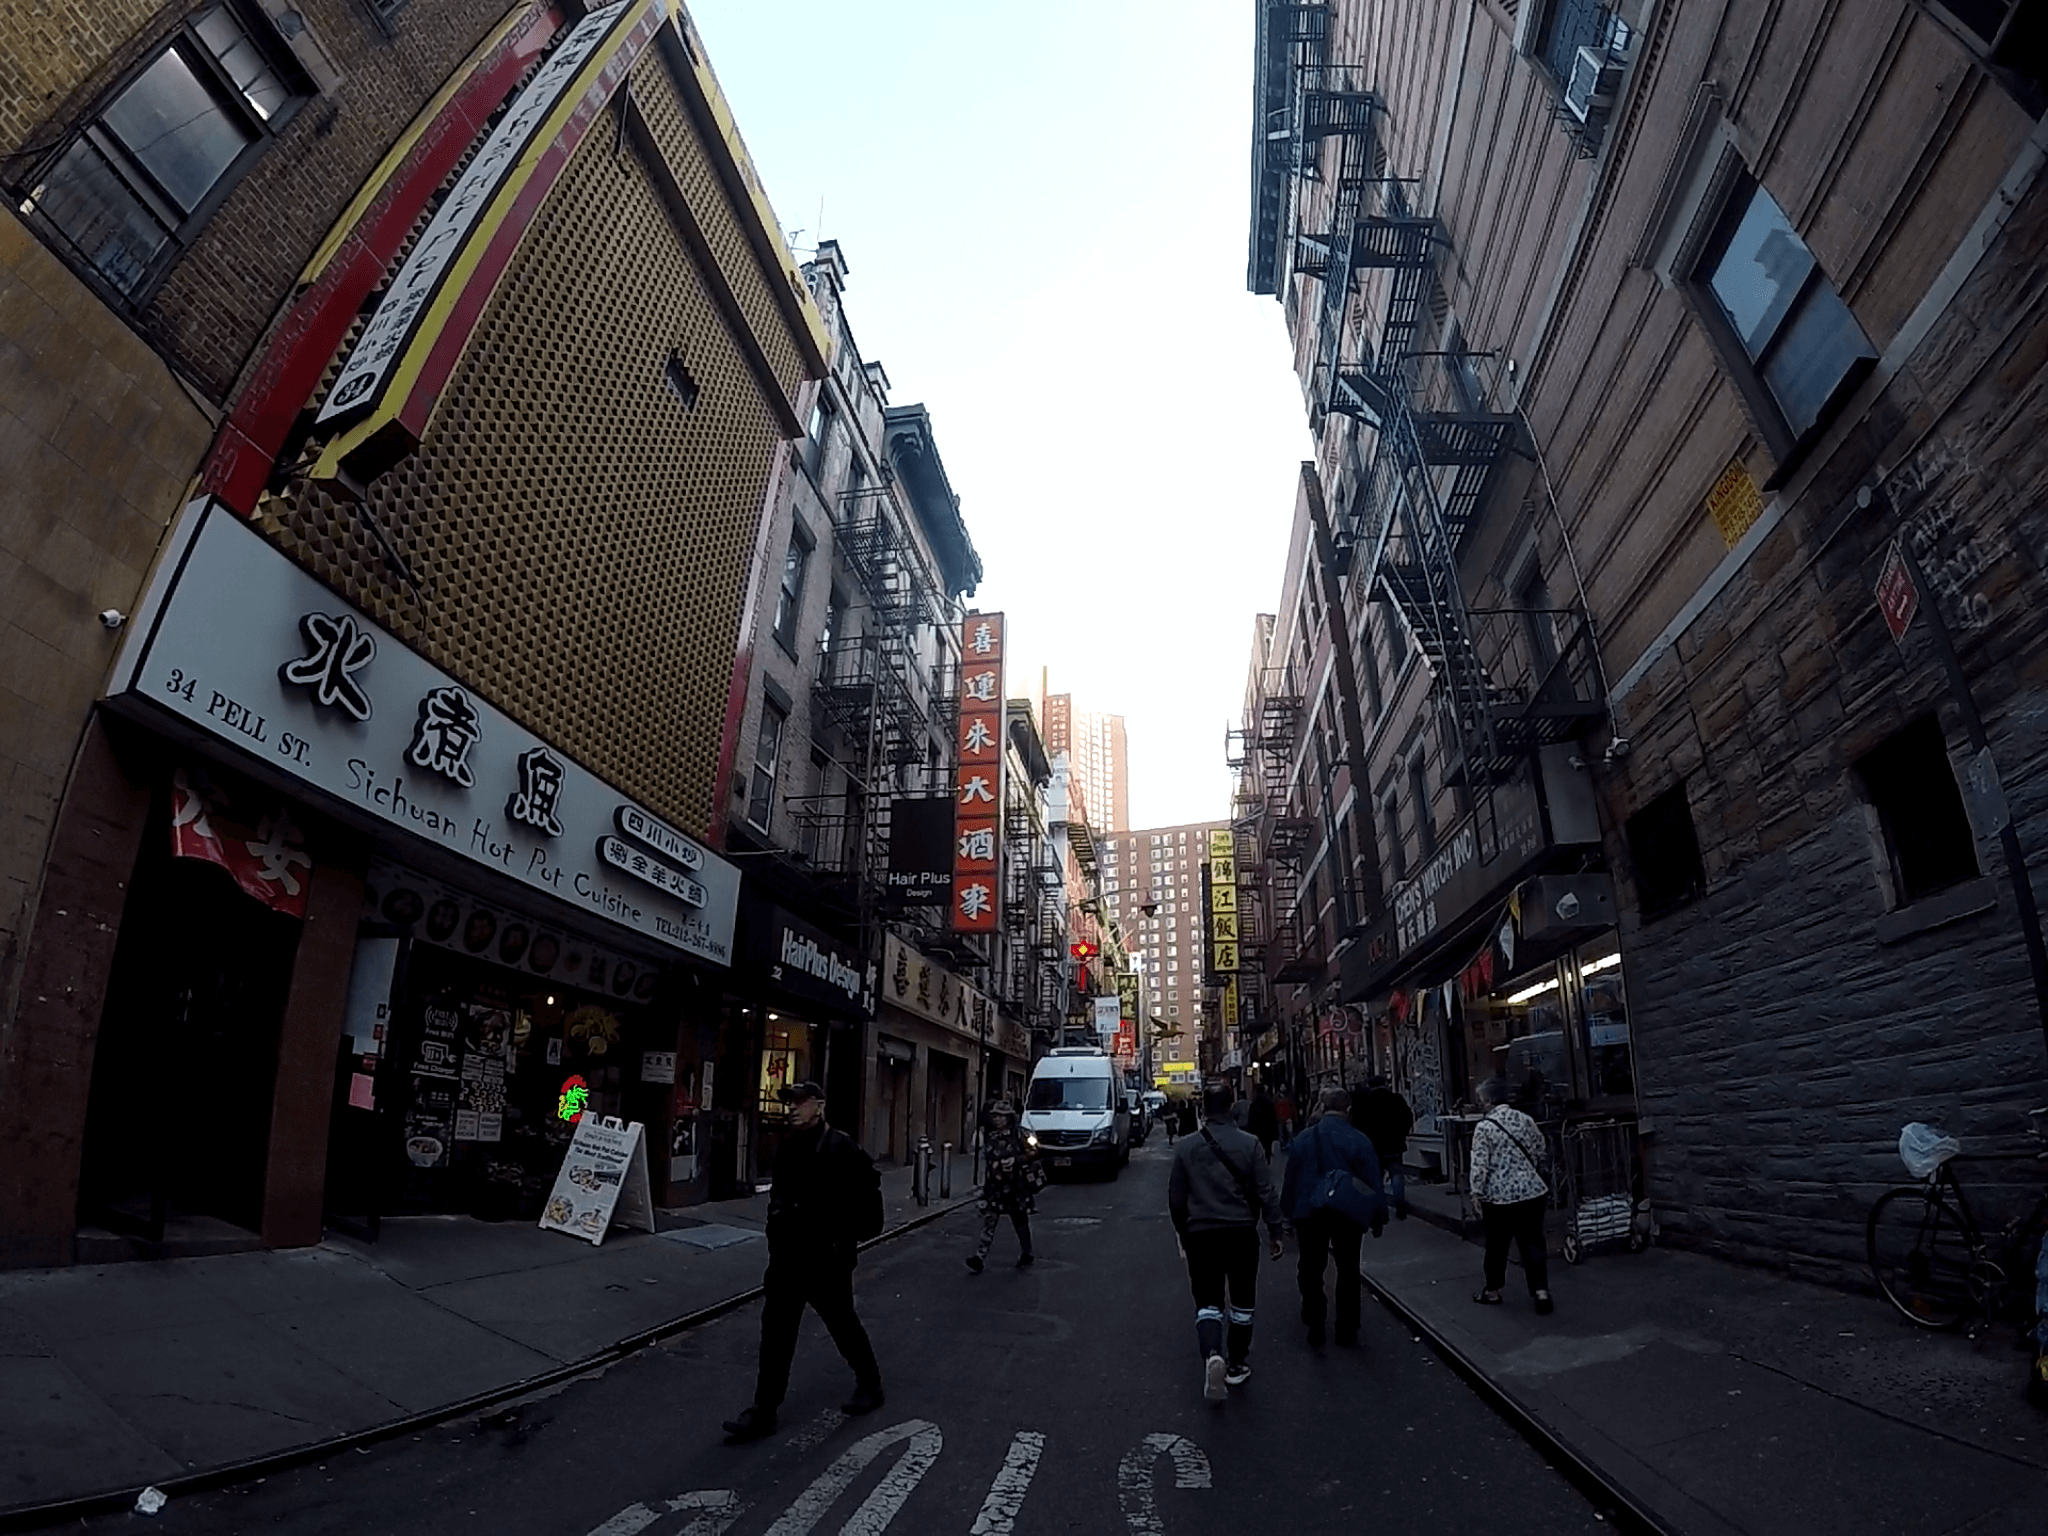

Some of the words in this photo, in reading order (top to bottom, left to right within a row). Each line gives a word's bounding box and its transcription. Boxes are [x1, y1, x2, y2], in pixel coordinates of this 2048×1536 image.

[406, 228, 456, 289] Pot
[165, 669, 197, 703] 34
[207, 690, 268, 746] PELL
[278, 731, 313, 768] ST.
[278, 612, 565, 840] 水煮魚
[957, 621, 1000, 923] 喜運來大酒家
[345, 758, 457, 840] Sichuan
[470, 816, 515, 867] Hot
[528, 845, 565, 893] Pot
[573, 873, 643, 925] Cuisine
[628, 812, 698, 863] 四川小炒
[1453, 829, 1473, 868] INC
[888, 871, 918, 886] Hair
[920, 871, 951, 885] Plus
[905, 887, 933, 899] Design
[1213, 860, 1236, 968] 錦江飯店
[781, 926, 806, 970] Hair
[805, 937, 828, 981] Plus
[549, 1042, 558, 1056] A
